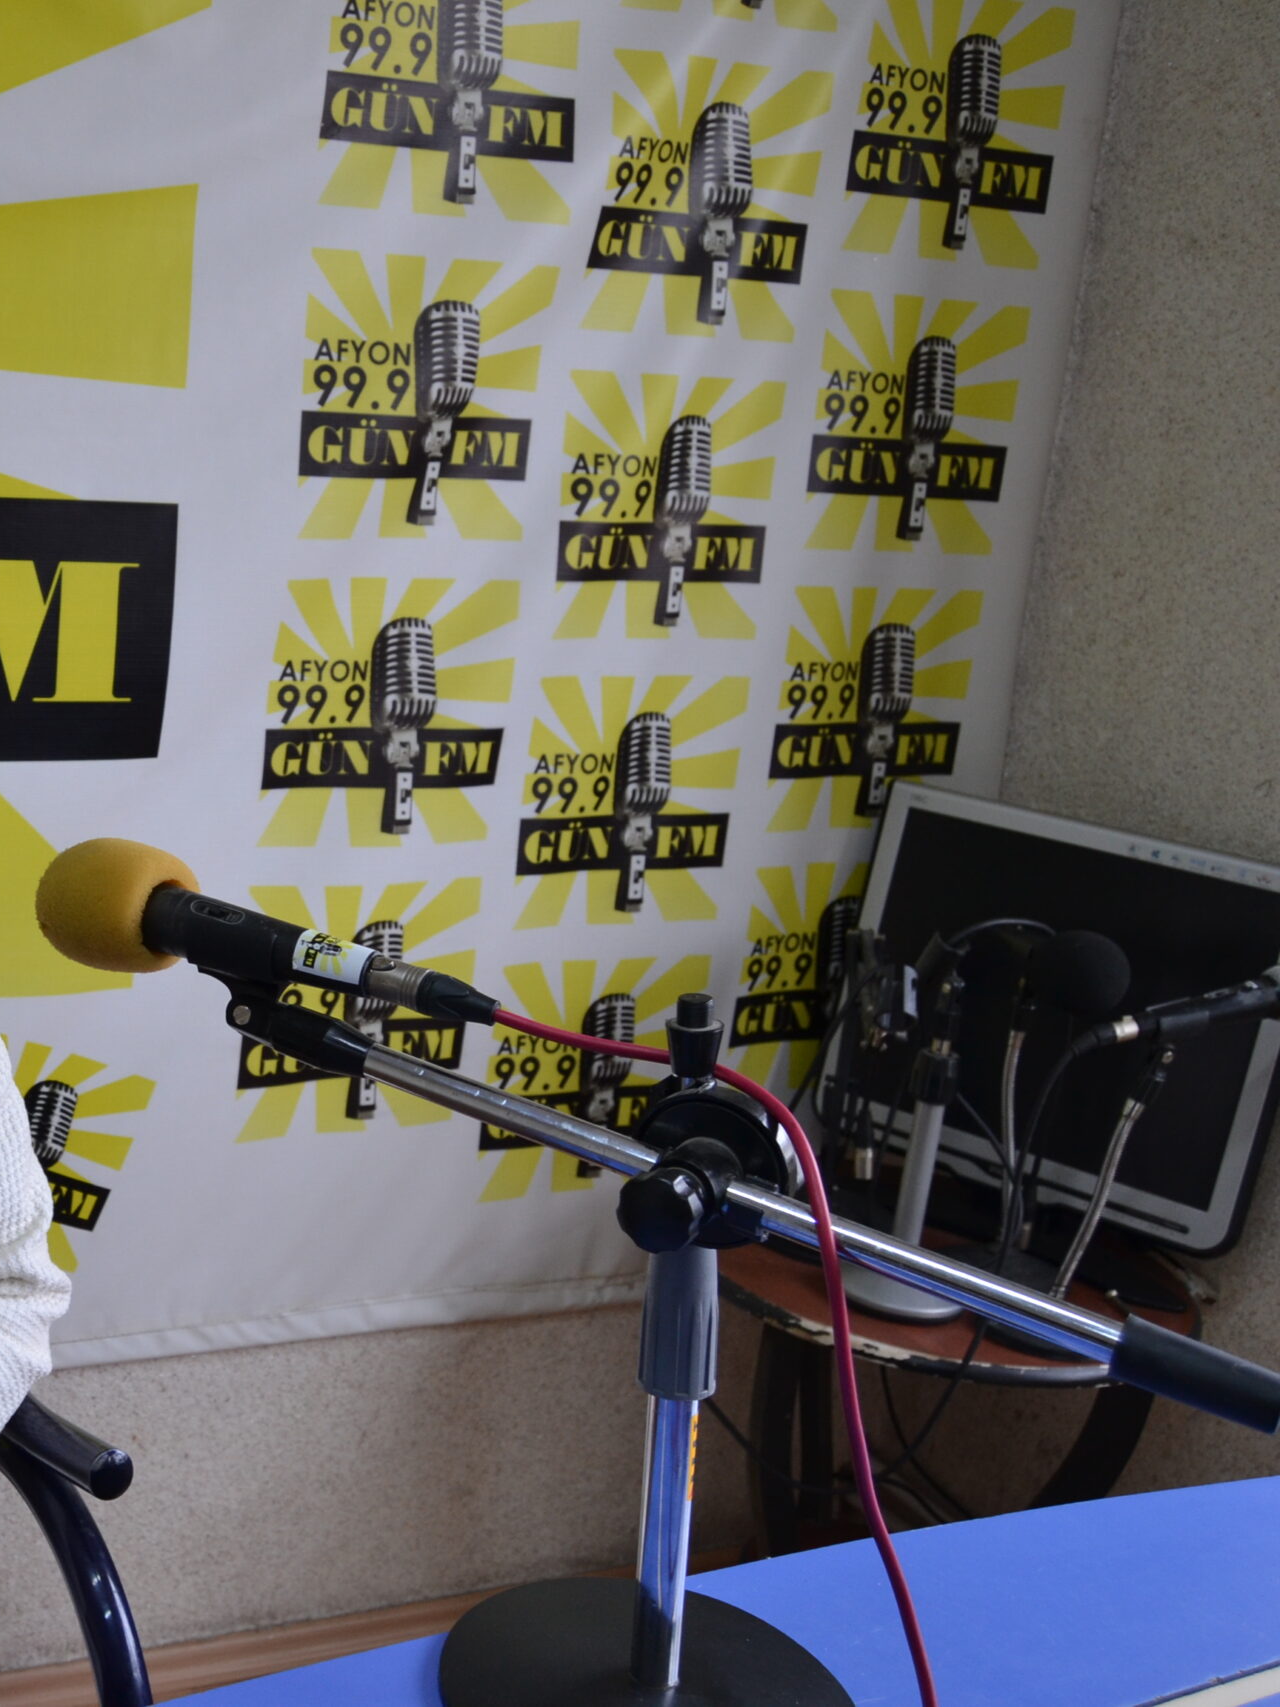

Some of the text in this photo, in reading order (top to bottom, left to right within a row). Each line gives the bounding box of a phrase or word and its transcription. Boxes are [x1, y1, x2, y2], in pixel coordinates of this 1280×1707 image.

[342, 0, 435, 30] AFYON
[340, 22, 433, 77] 99.9
[870, 63, 946, 94] AFYON
[330, 83, 567, 148] GÜN FM
[865, 87, 942, 134] 99.9
[619, 136, 689, 165] AFYON
[614, 161, 684, 208] 99.9
[855, 141, 1047, 201] GÜN FM
[597, 214, 799, 272] GÜN FM
[313, 338, 411, 366] AFYON
[312, 364, 411, 411] 99.9
[826, 369, 906, 396] AFYON
[824, 393, 902, 435] 99.9
[307, 418, 521, 468] GÜN FM
[571, 453, 657, 478] AFYON
[815, 441, 999, 491] GÜN FM
[570, 477, 652, 517] 99.9
[564, 526, 756, 572] GÜN FM
[278, 659, 369, 683] AFYON
[790, 660, 858, 683] AFYON
[276, 684, 366, 724] 99.9
[787, 683, 855, 720] 99.9
[270, 733, 497, 777] GÜN FM
[534, 752, 615, 775] AFYON
[776, 729, 949, 770] GÜN FM
[531, 776, 611, 815] 99.9
[524, 822, 721, 865] GÜN FM
[750, 931, 817, 957] AFYON
[748, 953, 813, 992] 99.9
[388, 1027, 458, 1060] FM
[495, 1055, 576, 1091] 99.9
